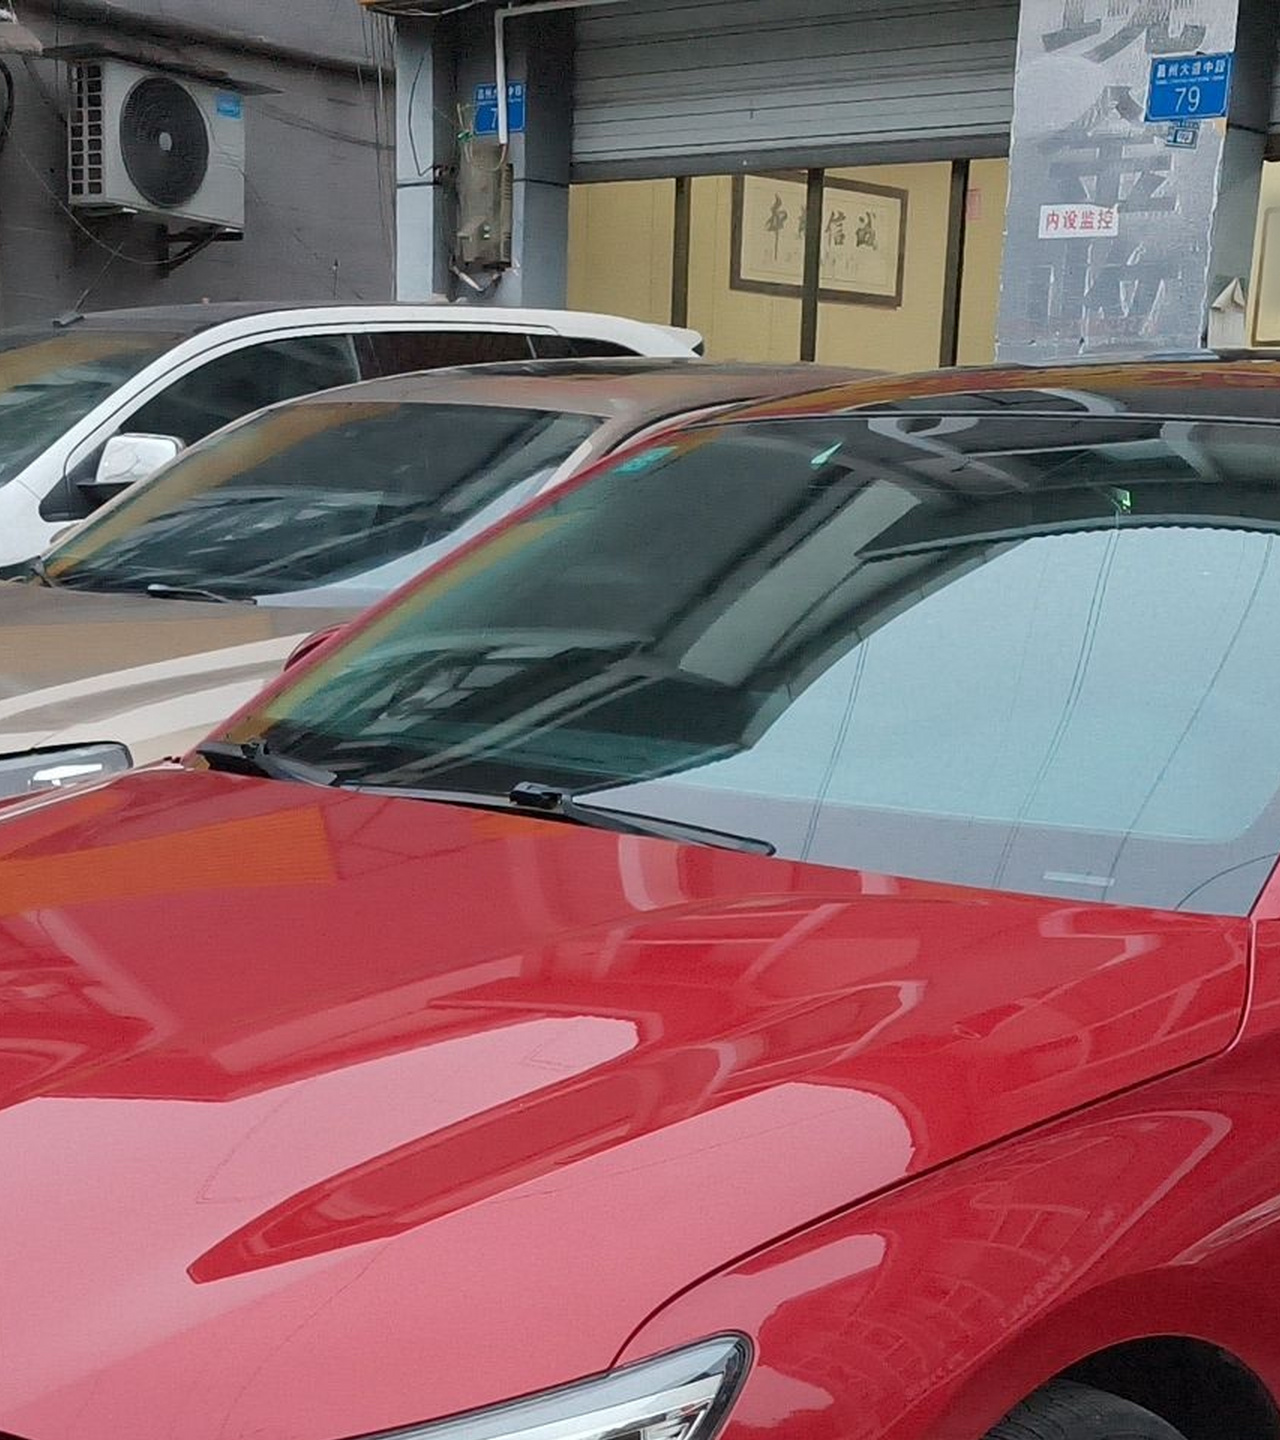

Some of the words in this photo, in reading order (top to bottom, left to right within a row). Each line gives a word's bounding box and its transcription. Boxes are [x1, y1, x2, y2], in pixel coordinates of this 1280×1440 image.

[1174, 85, 1201, 113] 79
[1046, 208, 1114, 232] 内设监控
